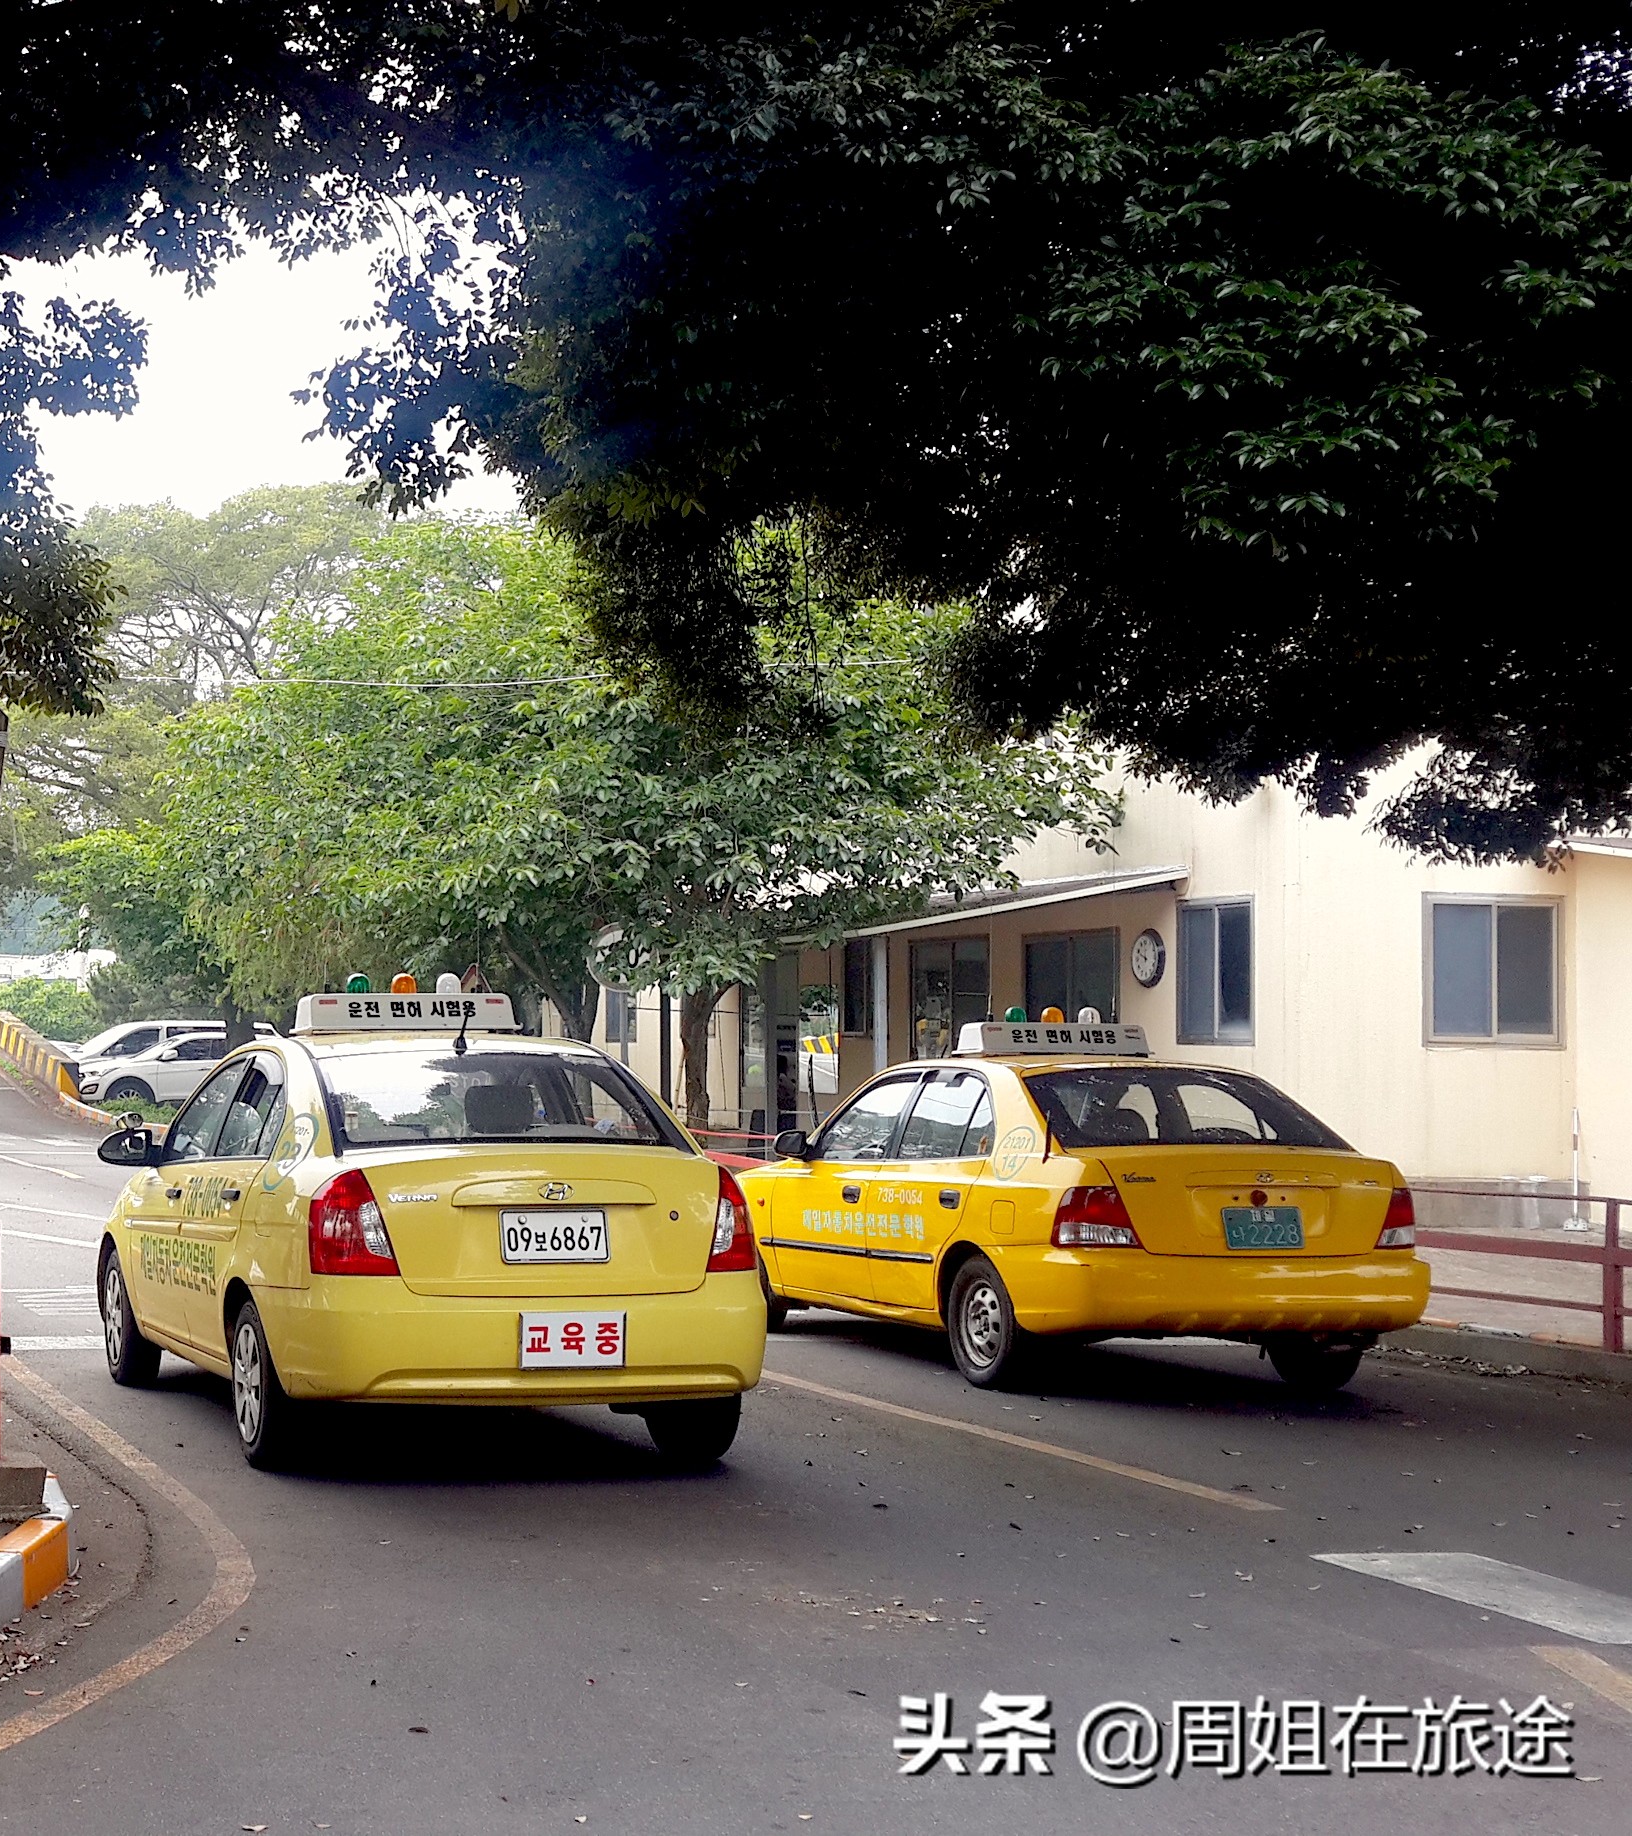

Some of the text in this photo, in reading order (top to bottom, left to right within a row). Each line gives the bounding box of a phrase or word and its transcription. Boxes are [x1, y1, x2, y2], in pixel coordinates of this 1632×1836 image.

[348, 1000, 476, 1018] 운전 면허 시험용
[1011, 1029, 1116, 1045] 운전 면허 시험용
[878, 1187, 923, 1205] 738-0054
[507, 1226, 602, 1252] 09보6867
